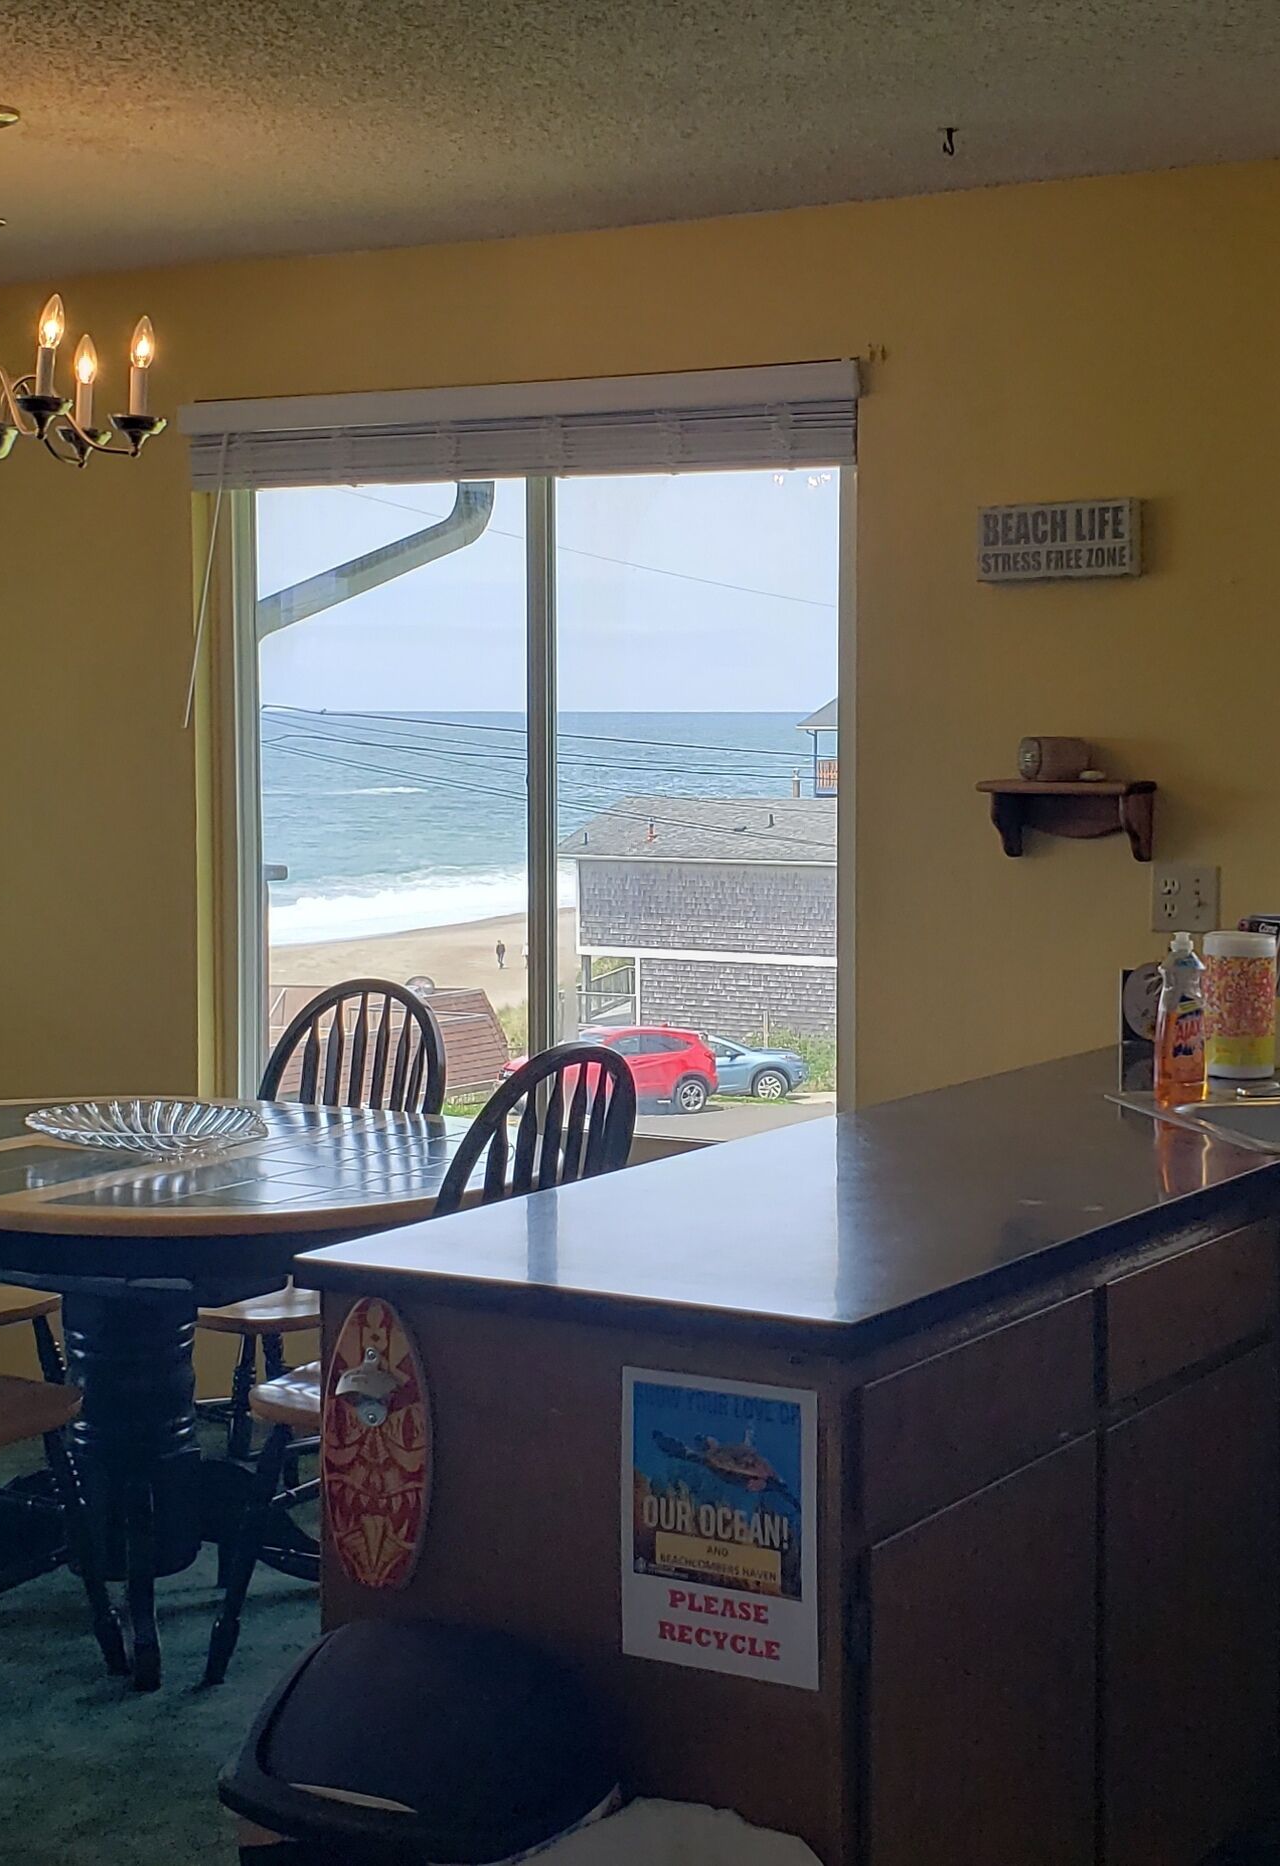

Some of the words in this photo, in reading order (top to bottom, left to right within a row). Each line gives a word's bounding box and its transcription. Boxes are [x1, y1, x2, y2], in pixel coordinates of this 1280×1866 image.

[983, 509, 1067, 547] BEACH
[1075, 506, 1125, 542] LIFE
[981, 550, 1042, 574] STRESS
[1046, 548, 1082, 571] FREE
[1086, 546, 1126, 568] ZONE
[687, 1388, 728, 1416] YOUR
[734, 1394, 774, 1422] LOVE
[780, 1402, 799, 1425] OF
[643, 1495, 693, 1533] OUR
[699, 1504, 789, 1550] OCEAN!
[660, 1553, 740, 1575] BEACHCOMBERS
[742, 1566, 777, 1582] HAVEN
[706, 1545, 729, 1557] AND
[668, 1589, 769, 1624] PLEASE
[658, 1620, 781, 1661] RECYCLE
